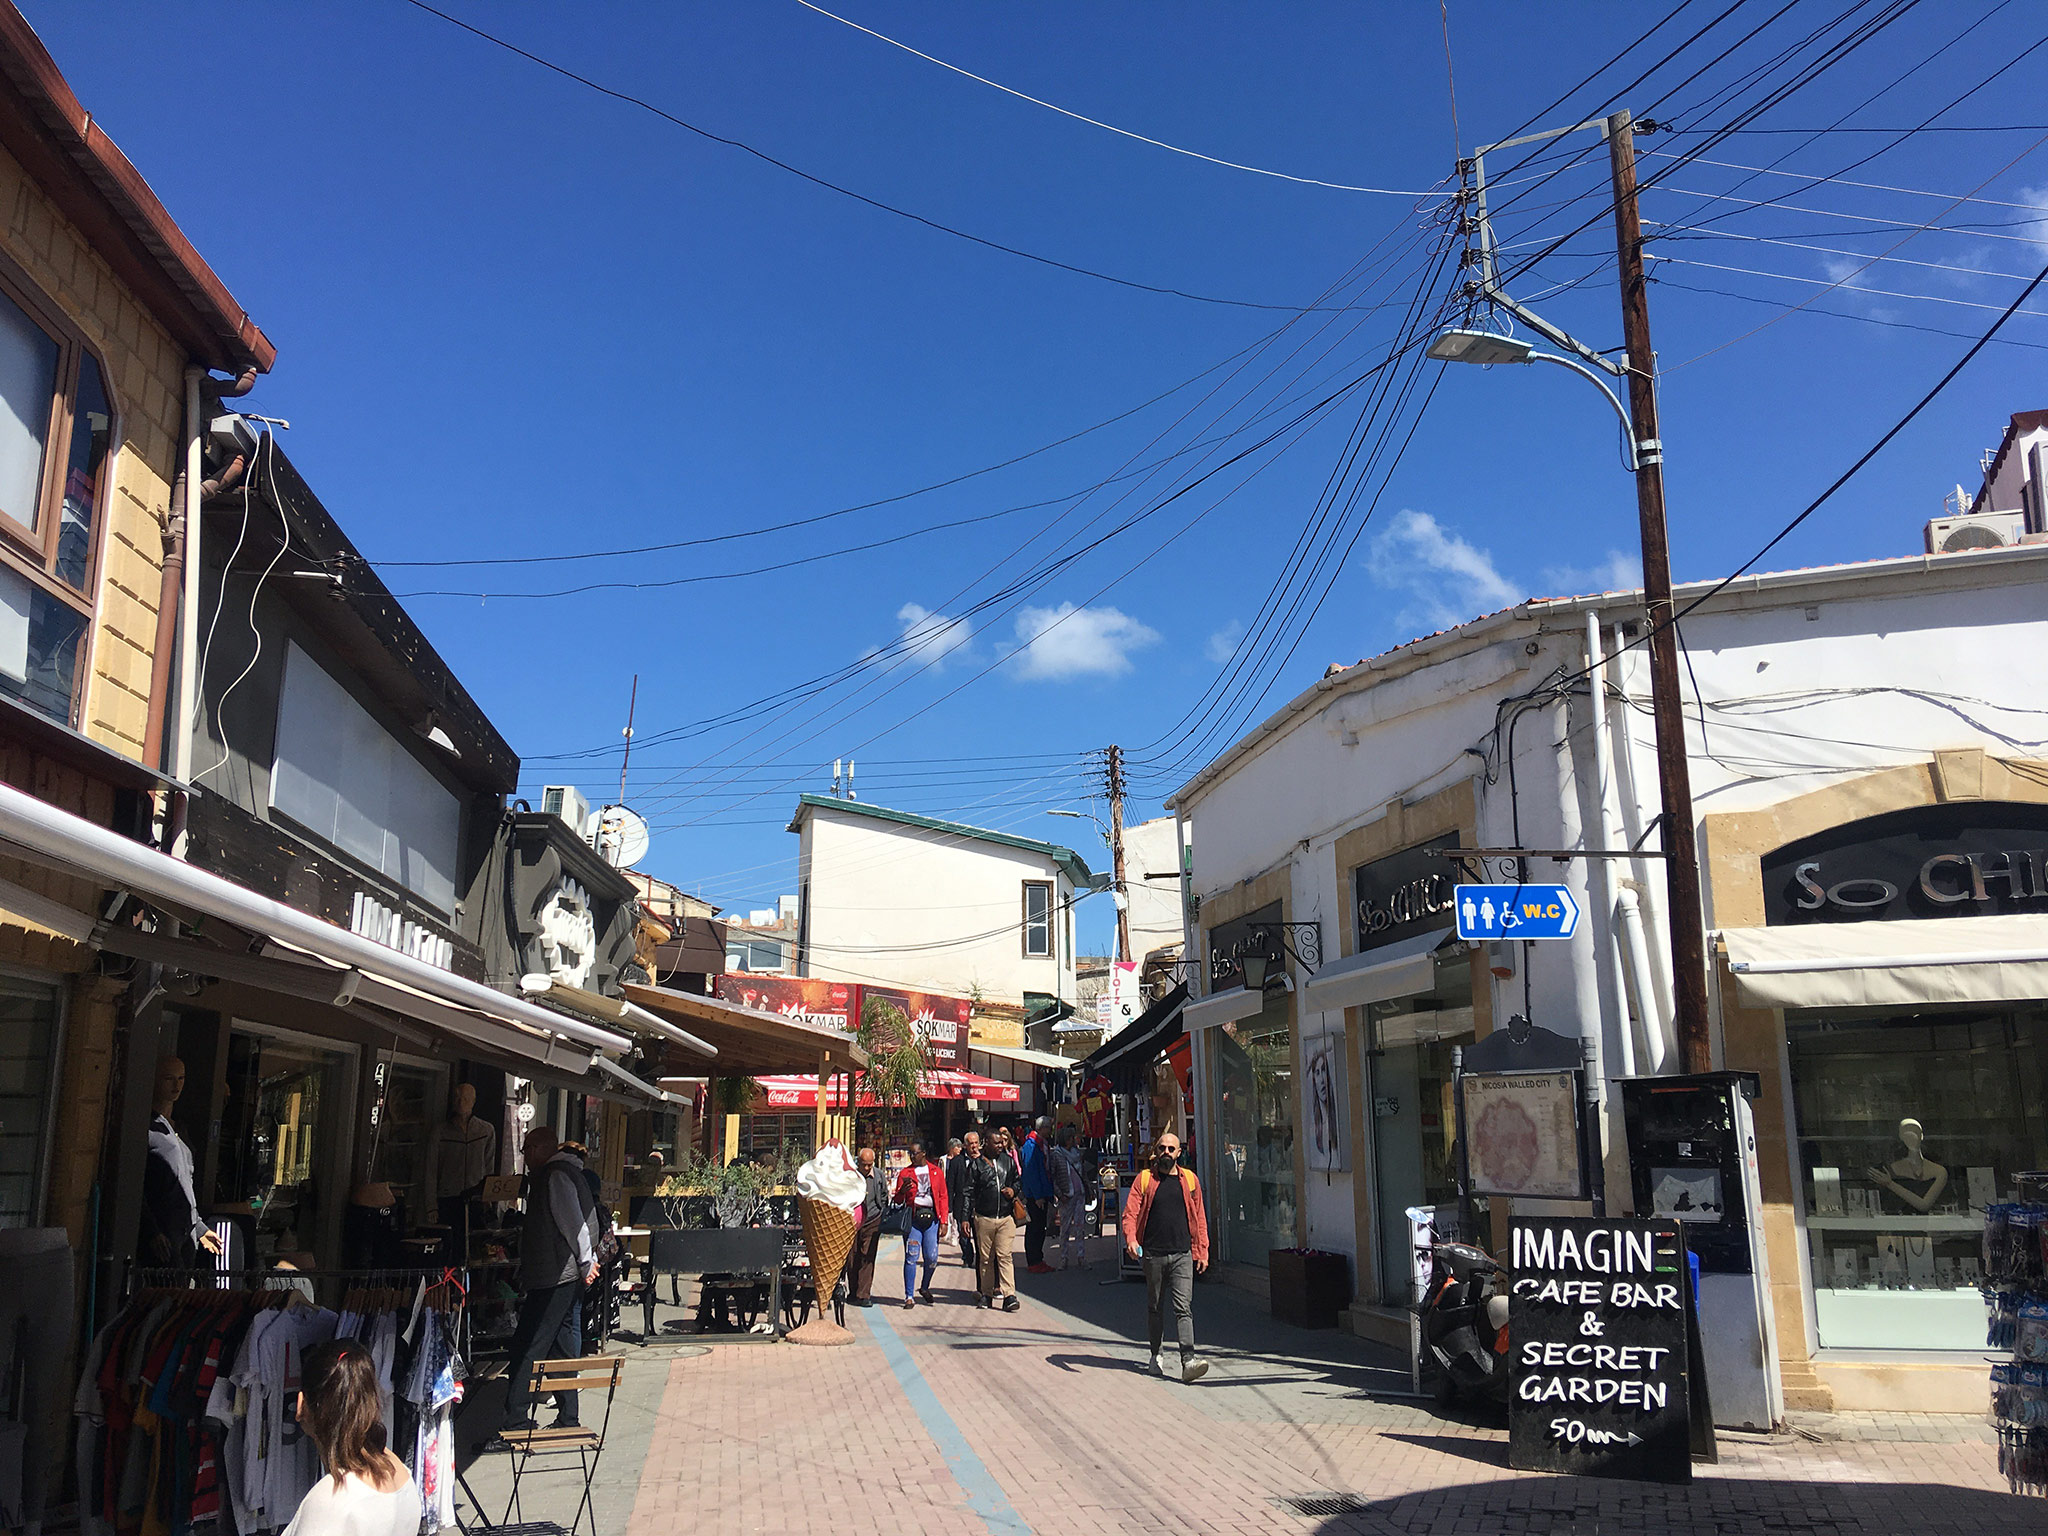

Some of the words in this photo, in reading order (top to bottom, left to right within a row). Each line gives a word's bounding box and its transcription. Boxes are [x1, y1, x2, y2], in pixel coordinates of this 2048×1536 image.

[1920, 850, 2048, 904] CHI
[1482, 1081, 1508, 1090] NICOSIA
[1508, 1080, 1535, 1089] WALLED
[1535, 1080, 1552, 1088] CITY
[1513, 1227, 1678, 1273] IMAGINE
[1513, 1278, 1603, 1305] CAFE
[1610, 1282, 1682, 1310] BAR
[1579, 1310, 1606, 1336] &
[1521, 1341, 1670, 1371] SECRET
[1518, 1374, 1667, 1411] GARDEN
